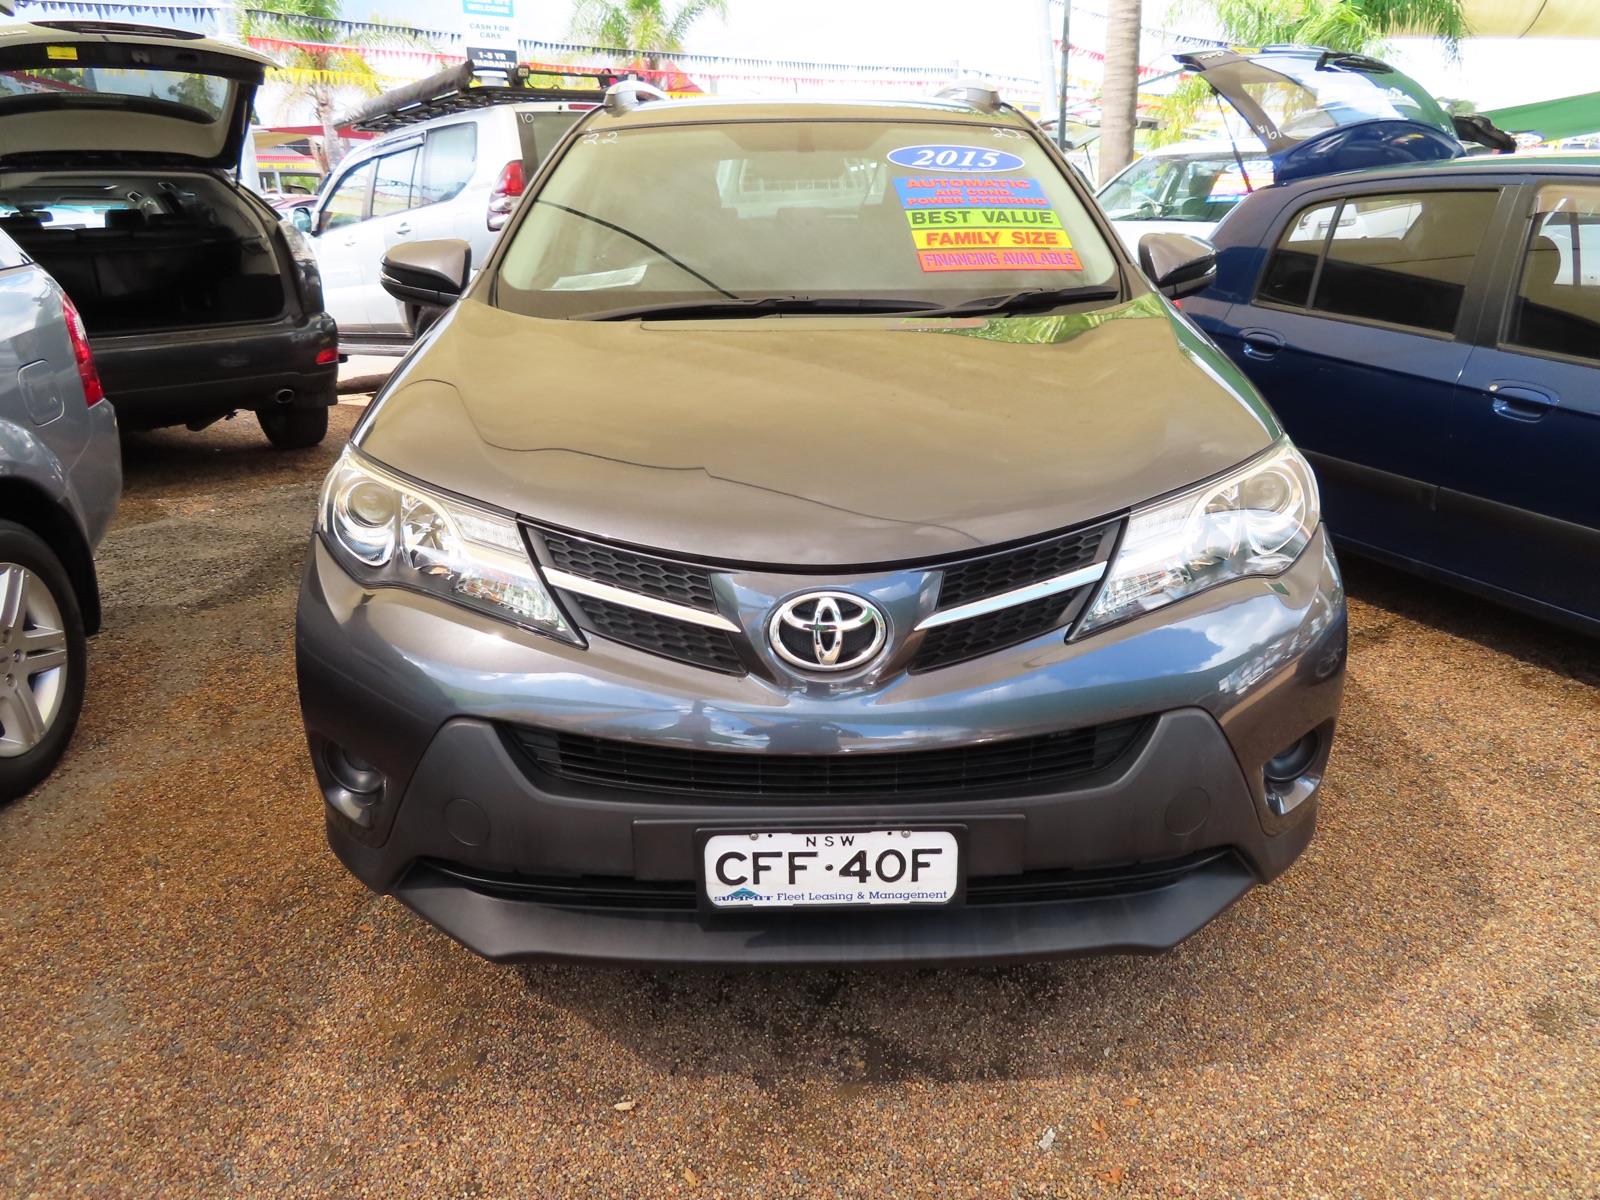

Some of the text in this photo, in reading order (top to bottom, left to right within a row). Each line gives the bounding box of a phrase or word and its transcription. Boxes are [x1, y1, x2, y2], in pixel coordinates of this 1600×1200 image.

[470, 22, 510, 33] CASH FOR
[480, 31, 501, 40] CARS
[520, 113, 534, 125] 10
[912, 150, 1001, 168] 2015
[906, 178, 1031, 189] AUTOMATIC
[968, 189, 1015, 197] COND.
[907, 197, 1048, 206] POWER STEERING
[912, 210, 1054, 225] BEST VALUE
[926, 231, 1059, 246] FAMILY SIZE
[925, 252, 1076, 267] FINANCING AVAILABLE
[805, 835, 855, 848] NSW
[714, 890, 948, 903] SUMMIT Fleet Leasing & Management
